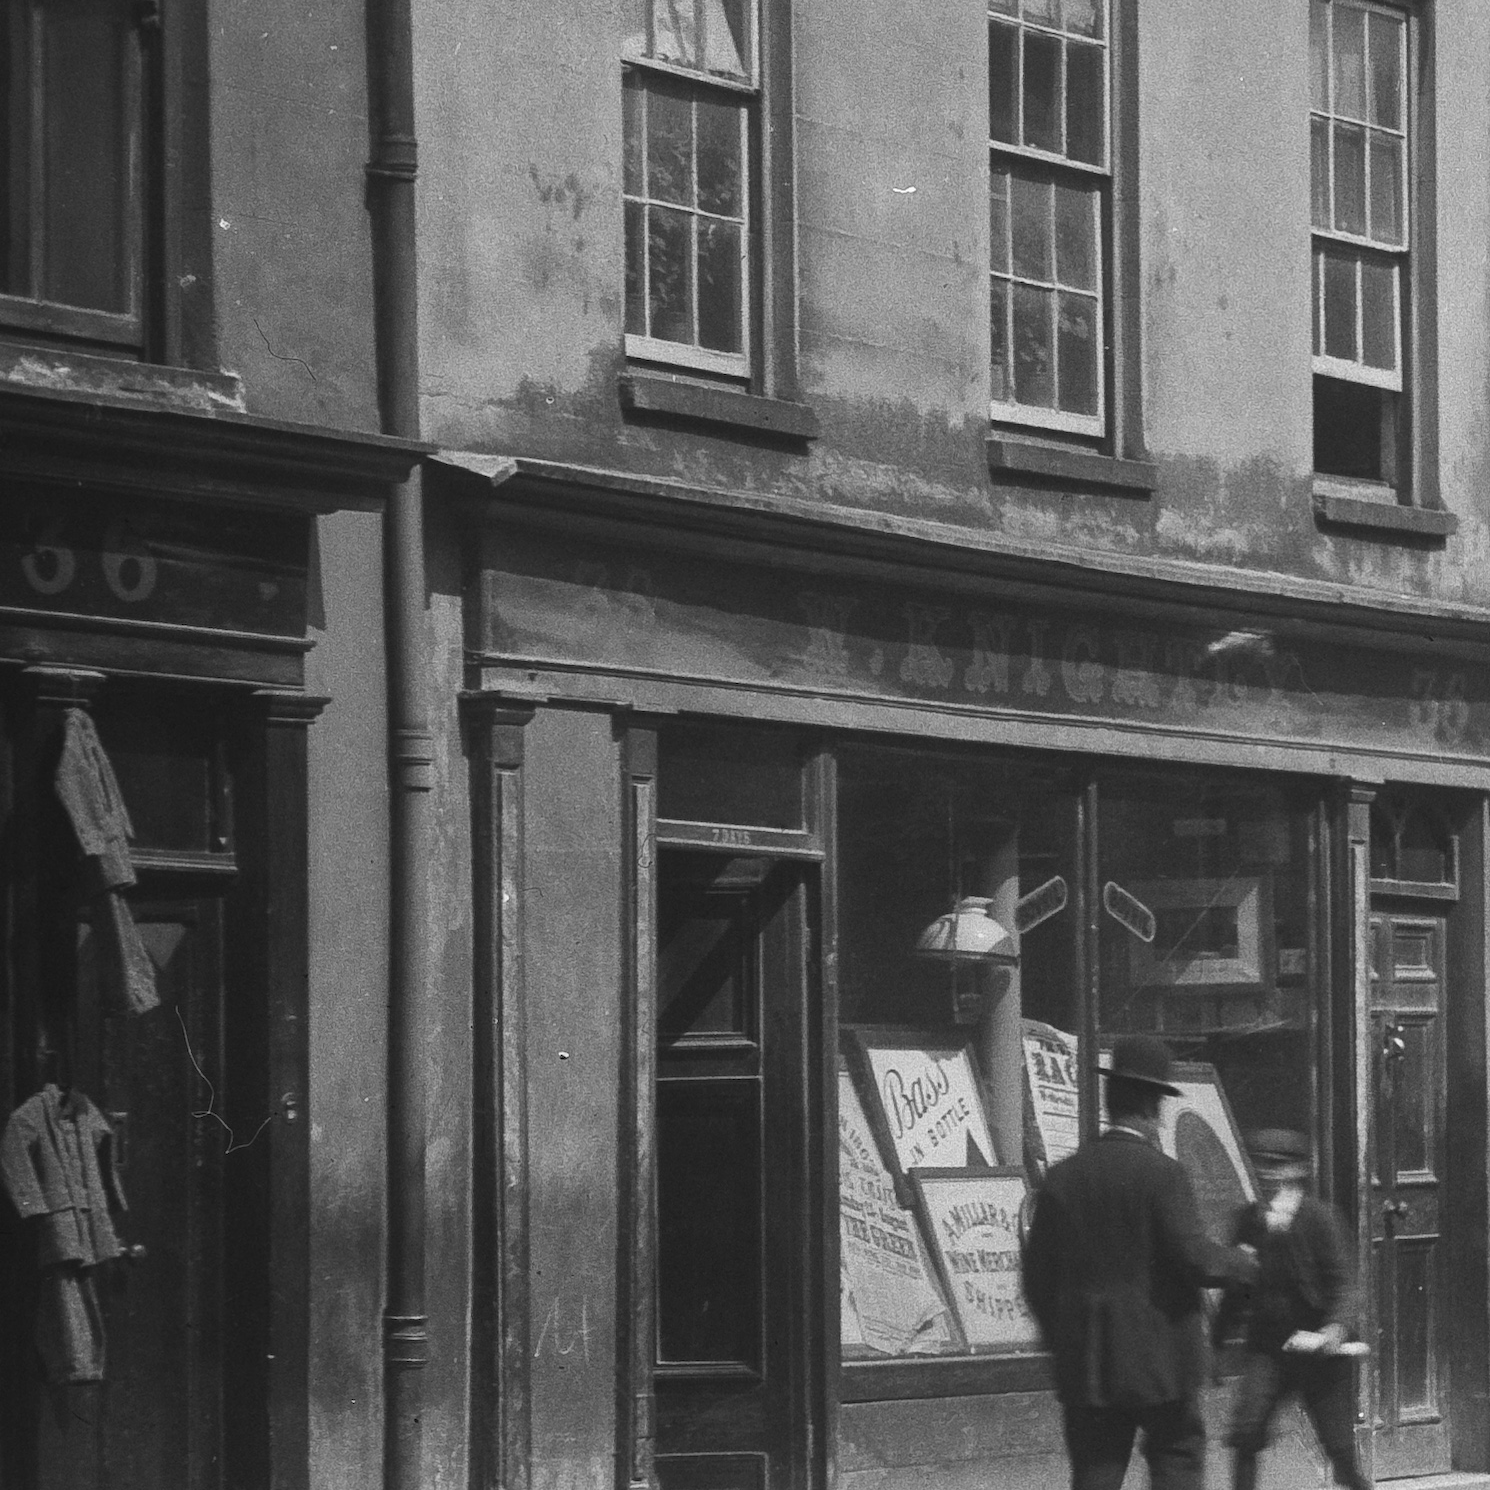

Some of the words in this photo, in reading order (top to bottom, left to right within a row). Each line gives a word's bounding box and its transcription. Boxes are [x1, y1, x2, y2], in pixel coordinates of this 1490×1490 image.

[882, 1058, 950, 1140] Bass
[927, 1096, 971, 1149] BOTTLE
[909, 1145, 925, 1166] IN
[963, 1279, 1028, 1322] SHIPPE
